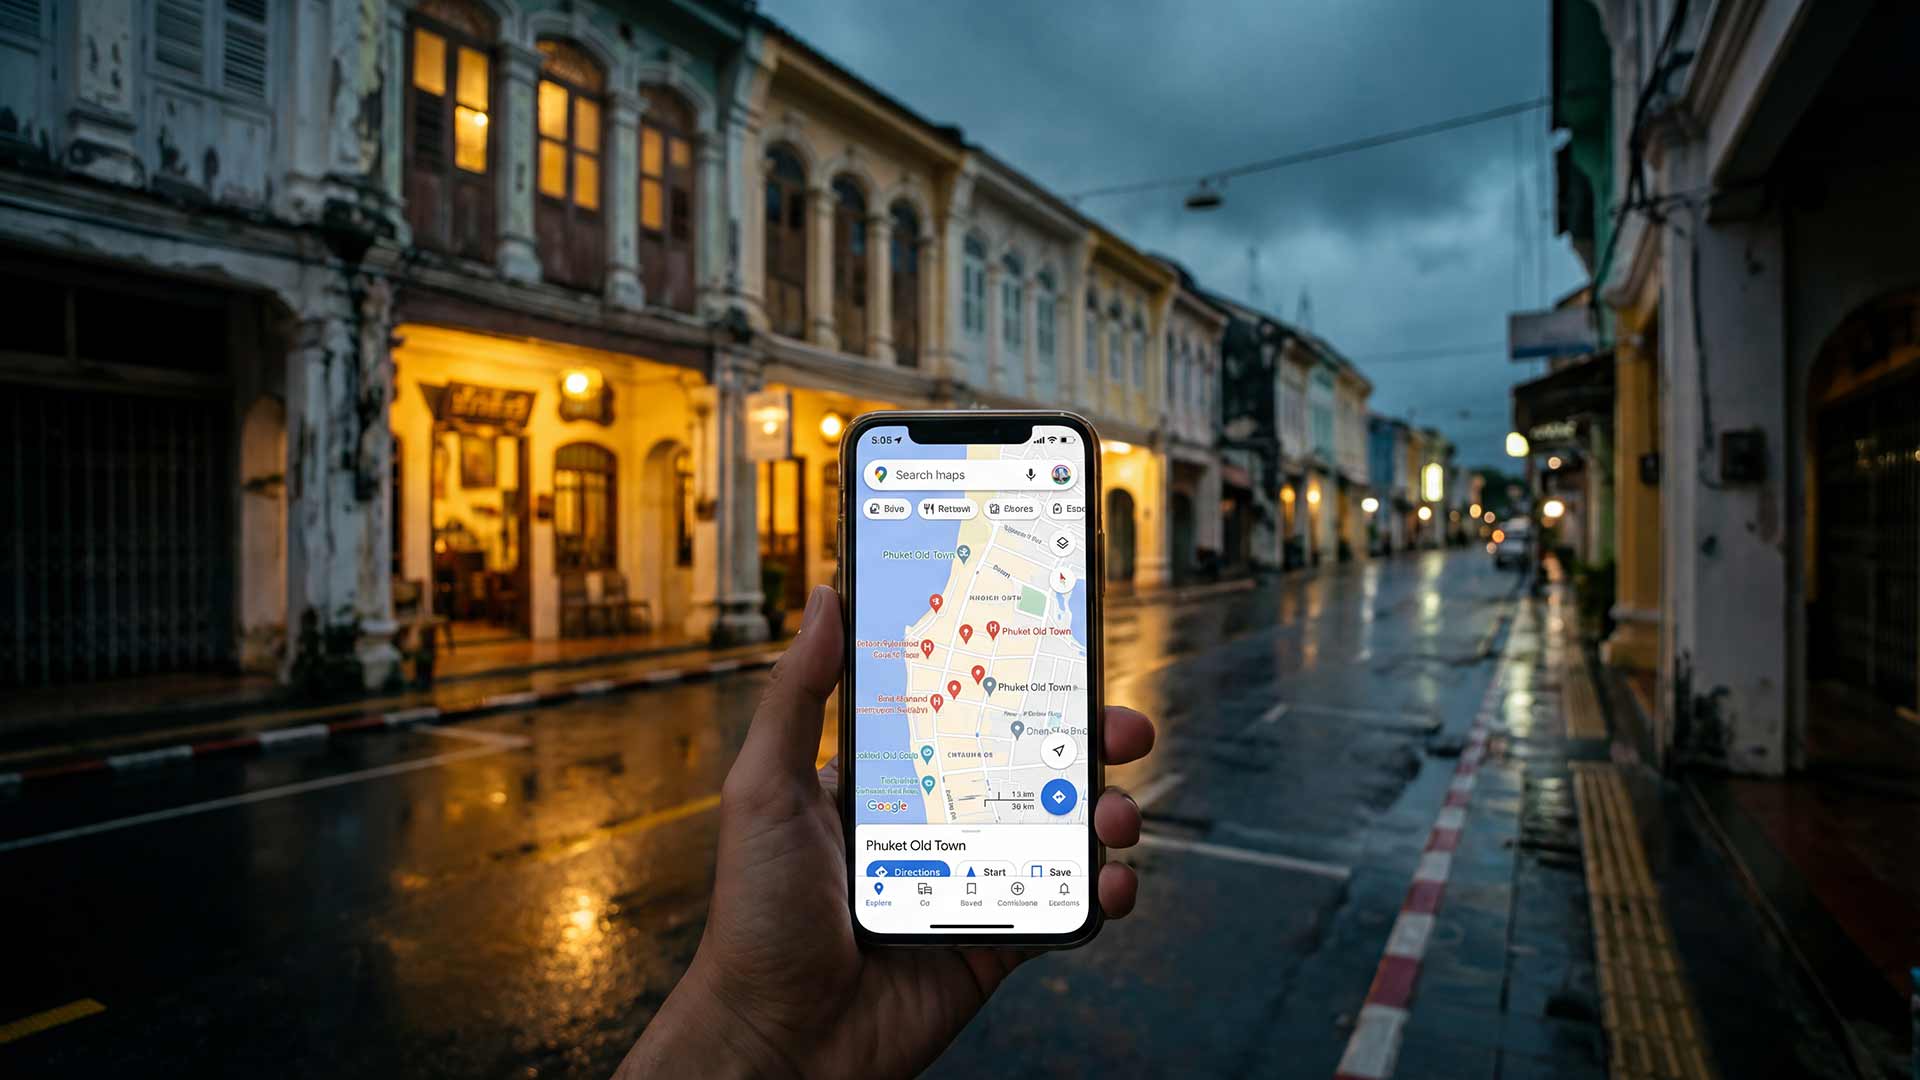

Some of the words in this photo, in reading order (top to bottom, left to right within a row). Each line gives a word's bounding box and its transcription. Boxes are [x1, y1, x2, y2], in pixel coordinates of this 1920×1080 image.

[896, 470, 933, 480] Search
[883, 551, 913, 559] Phuket
[915, 551, 930, 559] Old
[933, 551, 955, 559] Town
[1002, 627, 1031, 636] Phuket
[1033, 627, 1047, 636] Old
[1049, 627, 1072, 636] Town
[998, 683, 1029, 692] Phuket
[1030, 683, 1046, 692] Old
[1048, 683, 1072, 692] Town
[867, 800, 908, 813] Google
[866, 840, 908, 851] Phuket
[910, 840, 932, 851] Old
[934, 840, 966, 851] Town
[894, 868, 941, 877] Directions
[983, 868, 1007, 877] Start
[1050, 868, 1072, 877] Save
